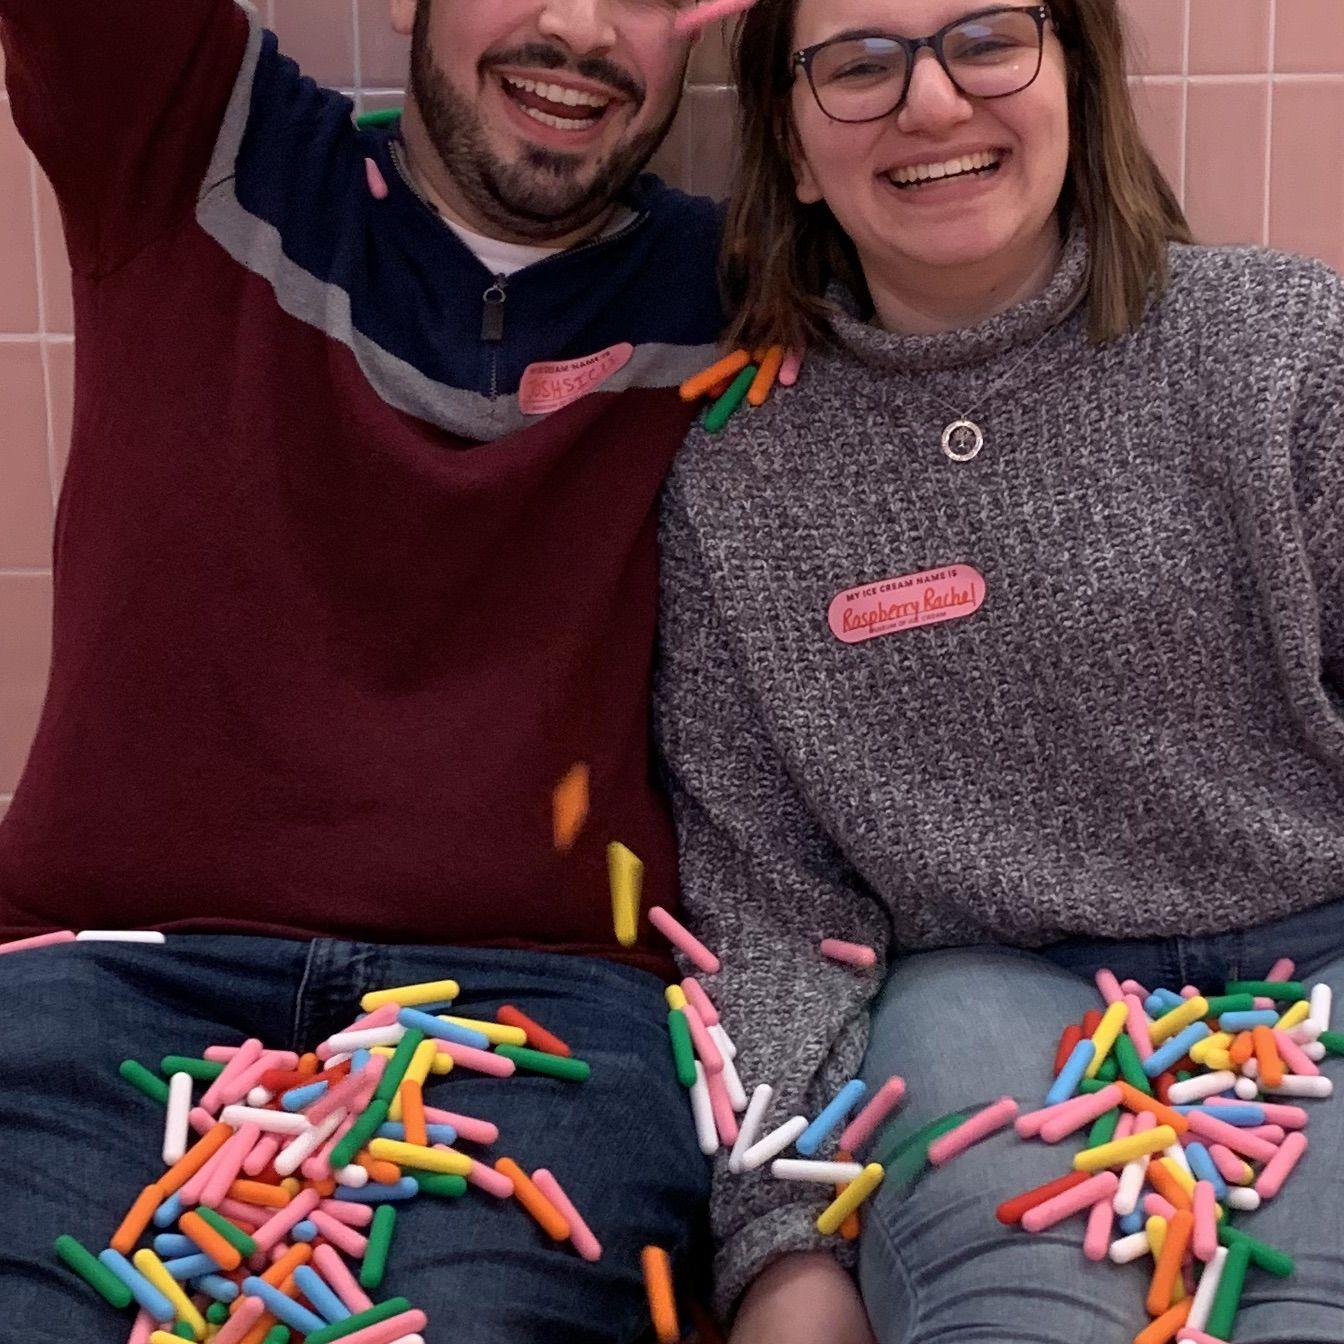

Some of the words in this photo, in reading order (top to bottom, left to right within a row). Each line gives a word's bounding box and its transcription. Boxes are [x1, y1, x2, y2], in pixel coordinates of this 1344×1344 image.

[846, 591, 860, 602] MY
[862, 588, 877, 599] ICE
[879, 579, 913, 593] CREAM
[916, 571, 946, 585] NAME
[948, 568, 958, 579] IS
[842, 601, 920, 633] Raspberry
[923, 582, 977, 613] Rachel
